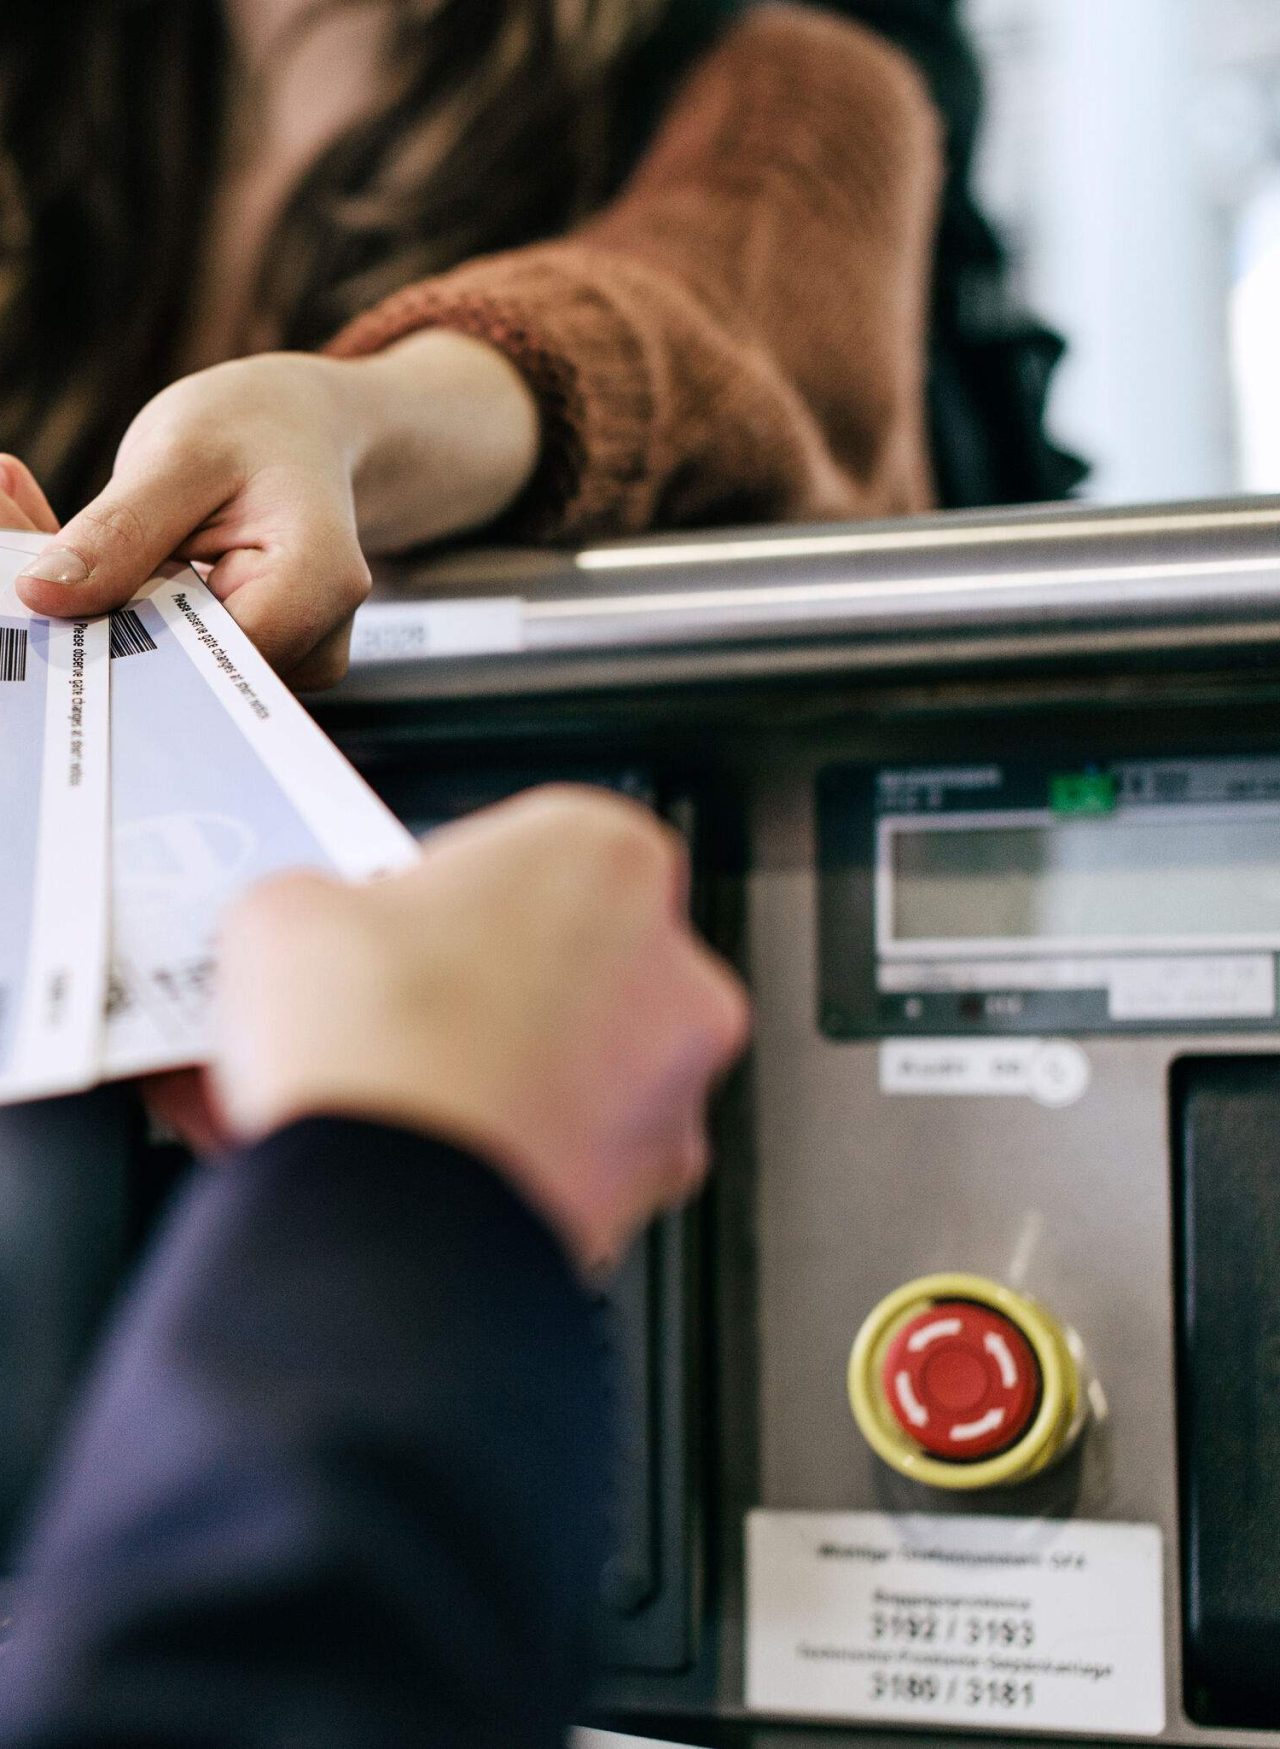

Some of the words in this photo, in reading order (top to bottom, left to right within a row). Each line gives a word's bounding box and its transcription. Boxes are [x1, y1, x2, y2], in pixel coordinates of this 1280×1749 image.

[72, 623, 89, 647] Please
[171, 593, 192, 612] Please
[185, 612, 209, 635] observe
[198, 634, 218, 648] gate
[212, 648, 237, 673] changes
[72, 648, 87, 677] observe
[68, 679, 85, 695] gate
[67, 698, 86, 727] changes
